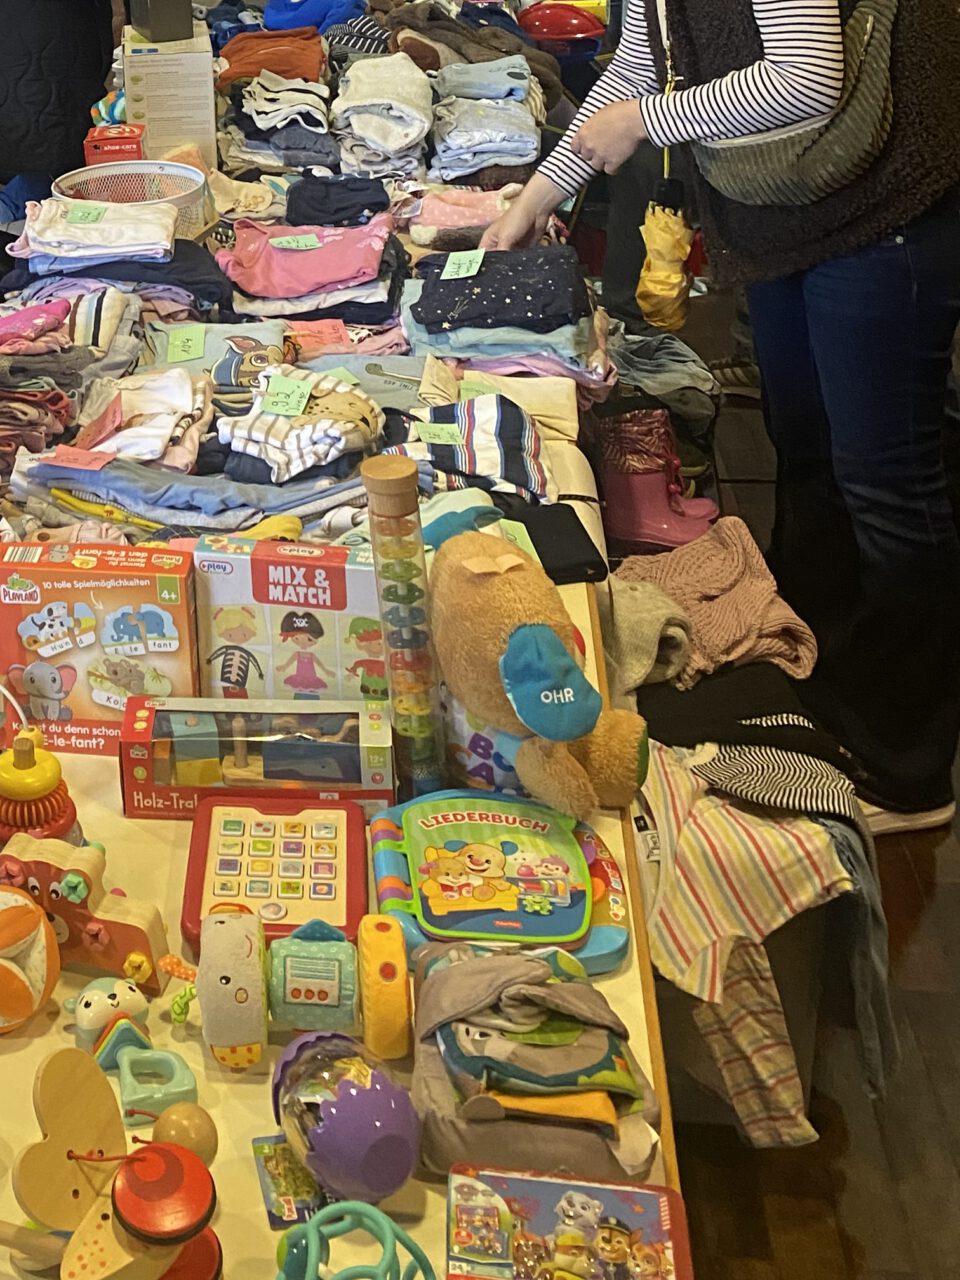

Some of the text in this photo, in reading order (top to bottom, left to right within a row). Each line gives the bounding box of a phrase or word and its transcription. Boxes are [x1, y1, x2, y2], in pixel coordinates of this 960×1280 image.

[54, 580, 72, 589] tolle
[73, 577, 151, 589] Spielmöglichkeiten
[268, 565, 330, 587] MIX &
[2, 589, 39, 603] PLAYLAND
[160, 591, 178, 601] 4+
[268, 584, 332, 606] MATCH
[540, 687, 575, 705] OHR
[48, 723, 62, 733] du
[64, 724, 90, 735] denn
[92, 726, 121, 737] schon
[468, 732, 494, 760] B
[133, 791, 198, 809] Holz-Tra
[419, 811, 551, 833] LIEDERBUCH
